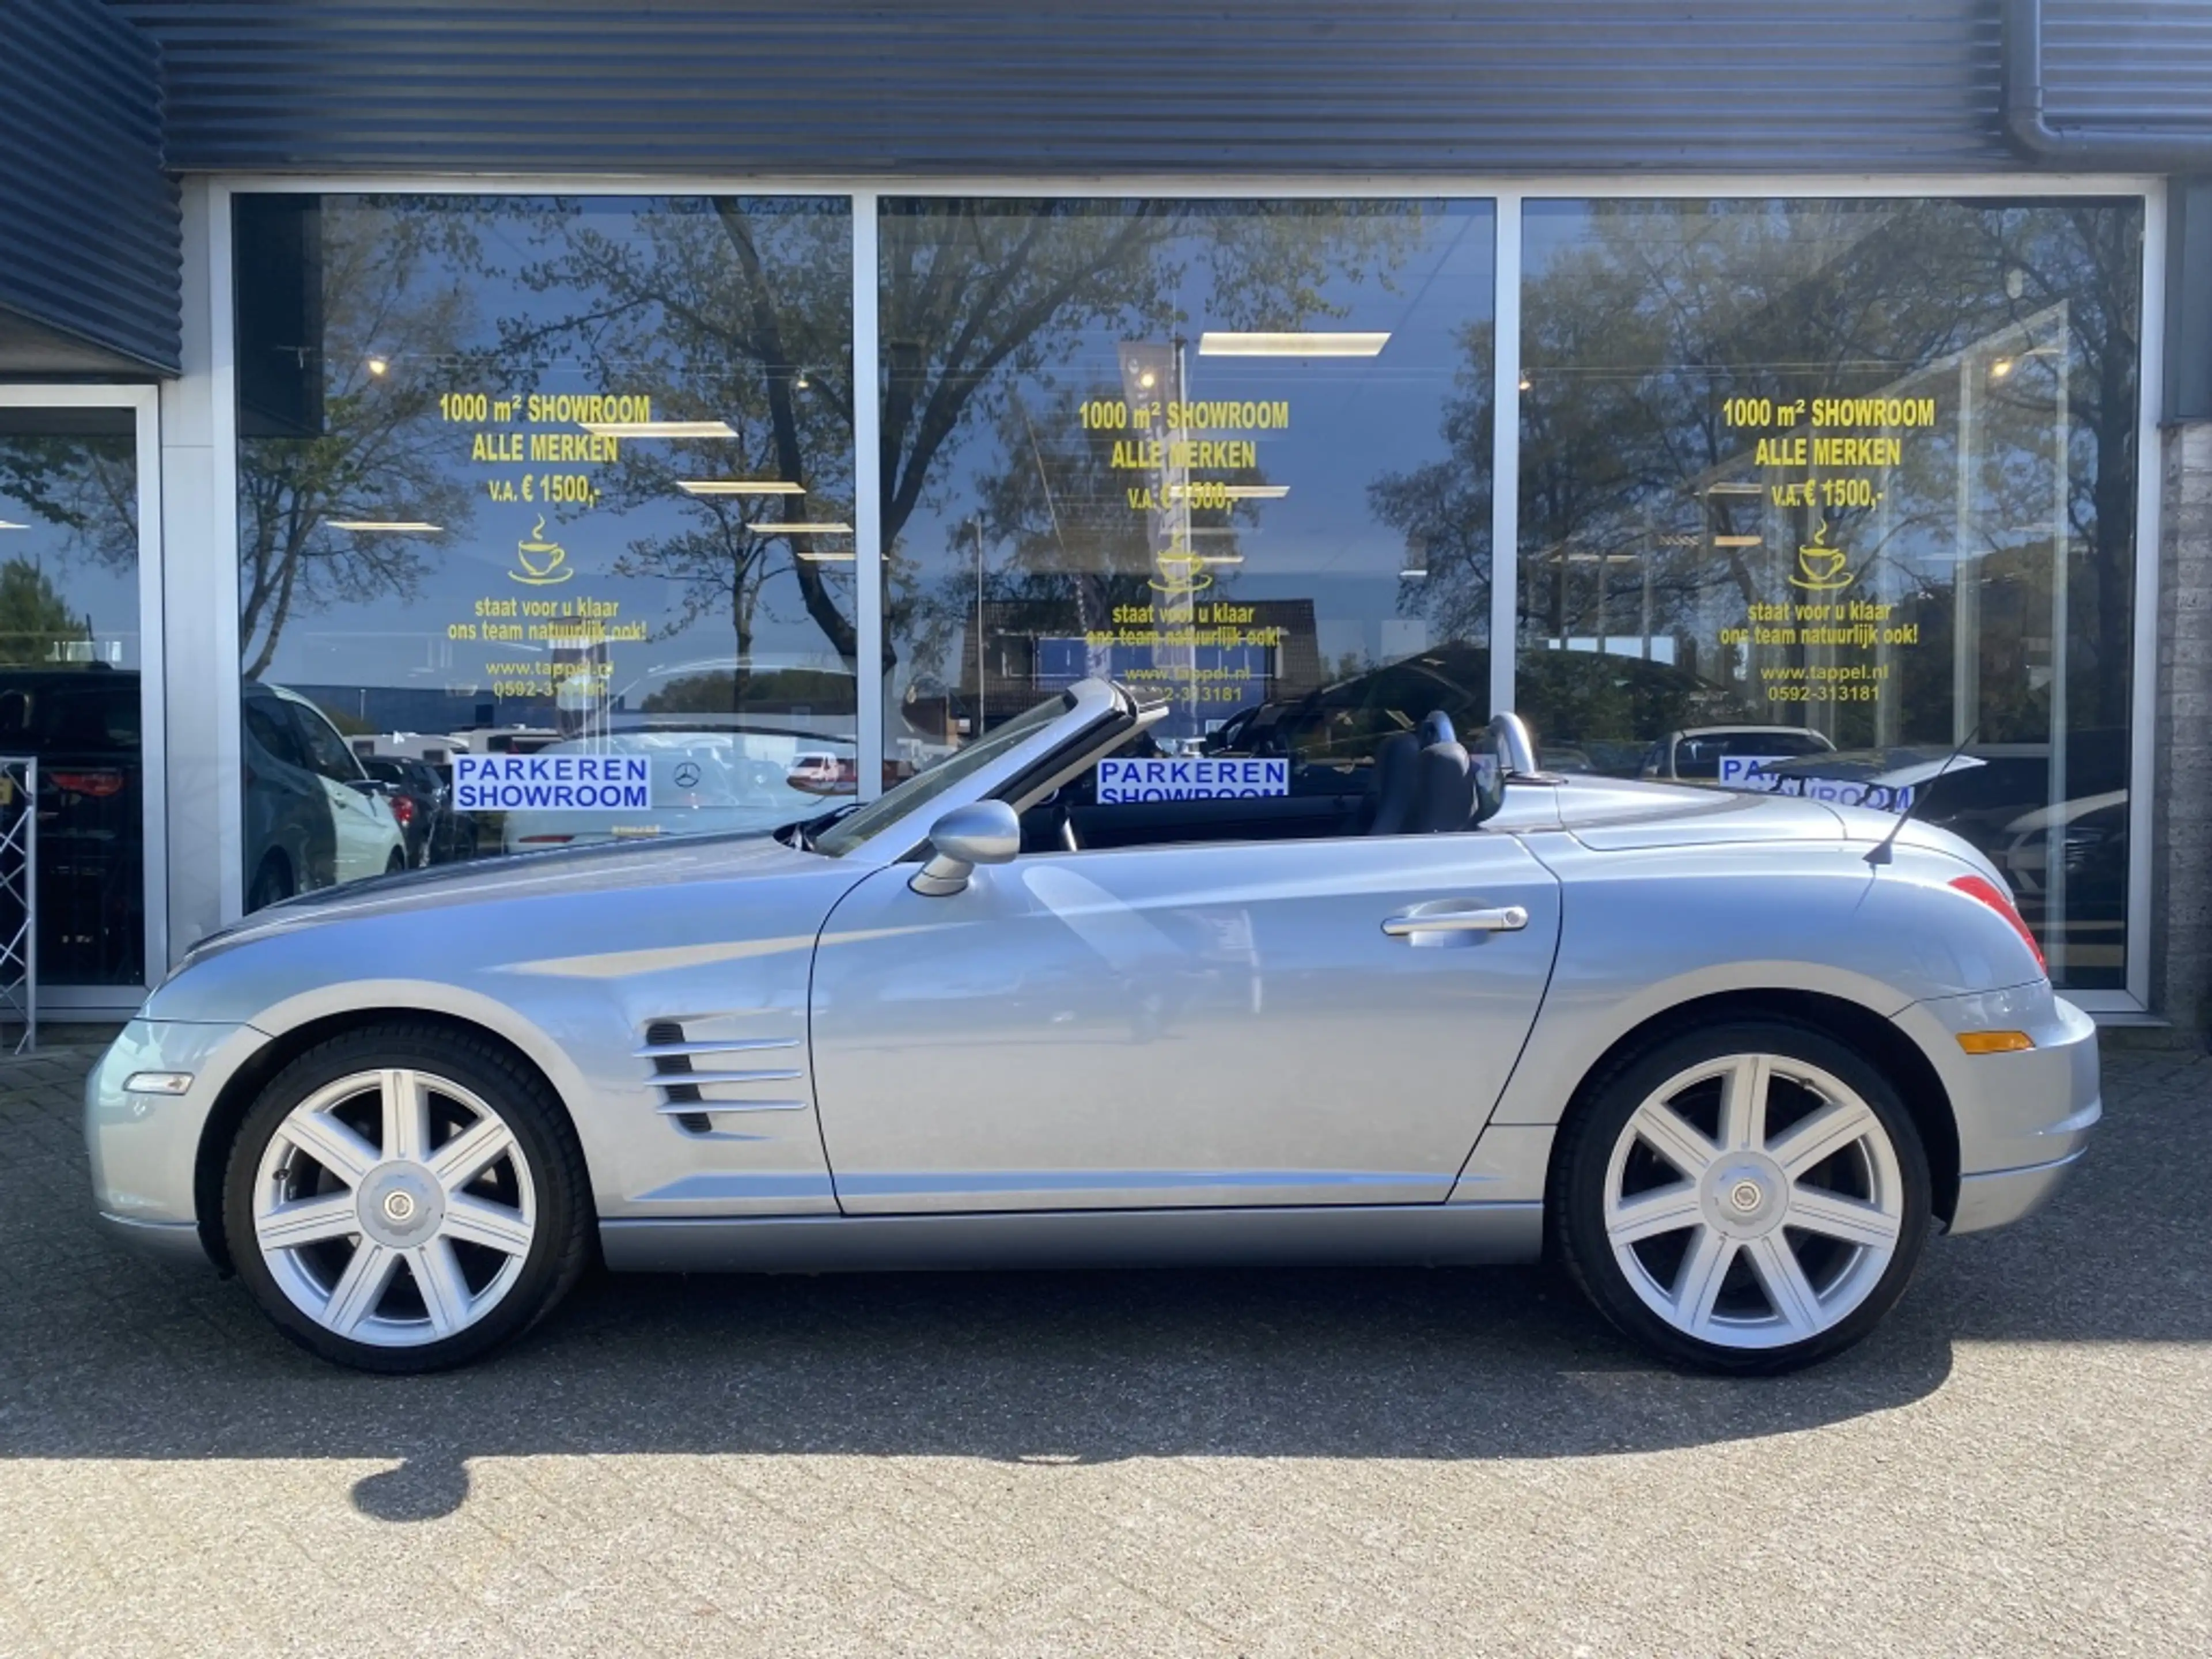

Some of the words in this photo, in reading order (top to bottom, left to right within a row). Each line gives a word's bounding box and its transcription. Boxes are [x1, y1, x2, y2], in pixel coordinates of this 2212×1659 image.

[440, 394, 486, 421] 1000
[494, 395, 521, 421] m²
[528, 395, 650, 423] SHOWROOM
[1080, 402, 1126, 428] 1000
[1133, 402, 1161, 428] m²
[1167, 402, 1289, 429] SHOWROOM
[1723, 399, 1770, 426] 1000
[1778, 400, 1806, 426] m²
[1812, 399, 1934, 426] SHOWROOM
[472, 434, 522, 461] ALLE
[531, 435, 618, 461] MERKEN
[1111, 441, 1161, 468] ALLE
[1169, 441, 1255, 468] MERKEN
[1755, 439, 1806, 465] ALLE
[1813, 439, 1900, 465] MERKEN
[489, 481, 517, 501] V.A.
[522, 475, 533, 501] €
[540, 475, 600, 507] 1500,-
[1127, 488, 1156, 509] V.A.
[1772, 486, 1800, 506] V.A.
[1804, 479, 1816, 506] €
[1823, 479, 1884, 510] 1500,-
[475, 597, 517, 616] staat
[522, 600, 555, 616] voor
[563, 600, 572, 616] u
[578, 597, 619, 616] klaar
[1113, 603, 1154, 623] staat
[1160, 607, 1194, 623] voor
[1199, 607, 1207, 623] u
[1214, 603, 1254, 623] klaar
[1748, 601, 1789, 620] staat
[1796, 604, 1830, 620] voor
[1835, 605, 1843, 620] u
[1850, 601, 1892, 620] klaar
[448, 624, 475, 639] ons
[482, 621, 522, 639] team
[529, 620, 605, 643] natuurlijk
[612, 621, 647, 640] ook!
[1085, 629, 1115, 646] ons
[1119, 627, 1158, 646] team
[1166, 627, 1240, 650] natuurlijk
[1247, 627, 1280, 646] ook!
[1721, 627, 1749, 645] ons
[1755, 625, 1795, 645] team
[1801, 624, 1878, 649] natuurlijk
[1884, 624, 1918, 645] ook!
[1761, 664, 1889, 683] www.tappel.nl
[1768, 685, 1879, 701] 0592-313181
[460, 759, 646, 781] PARKEREN
[1101, 762, 1284, 783] PARKEREN
[458, 785, 646, 807] SHOWROOM
